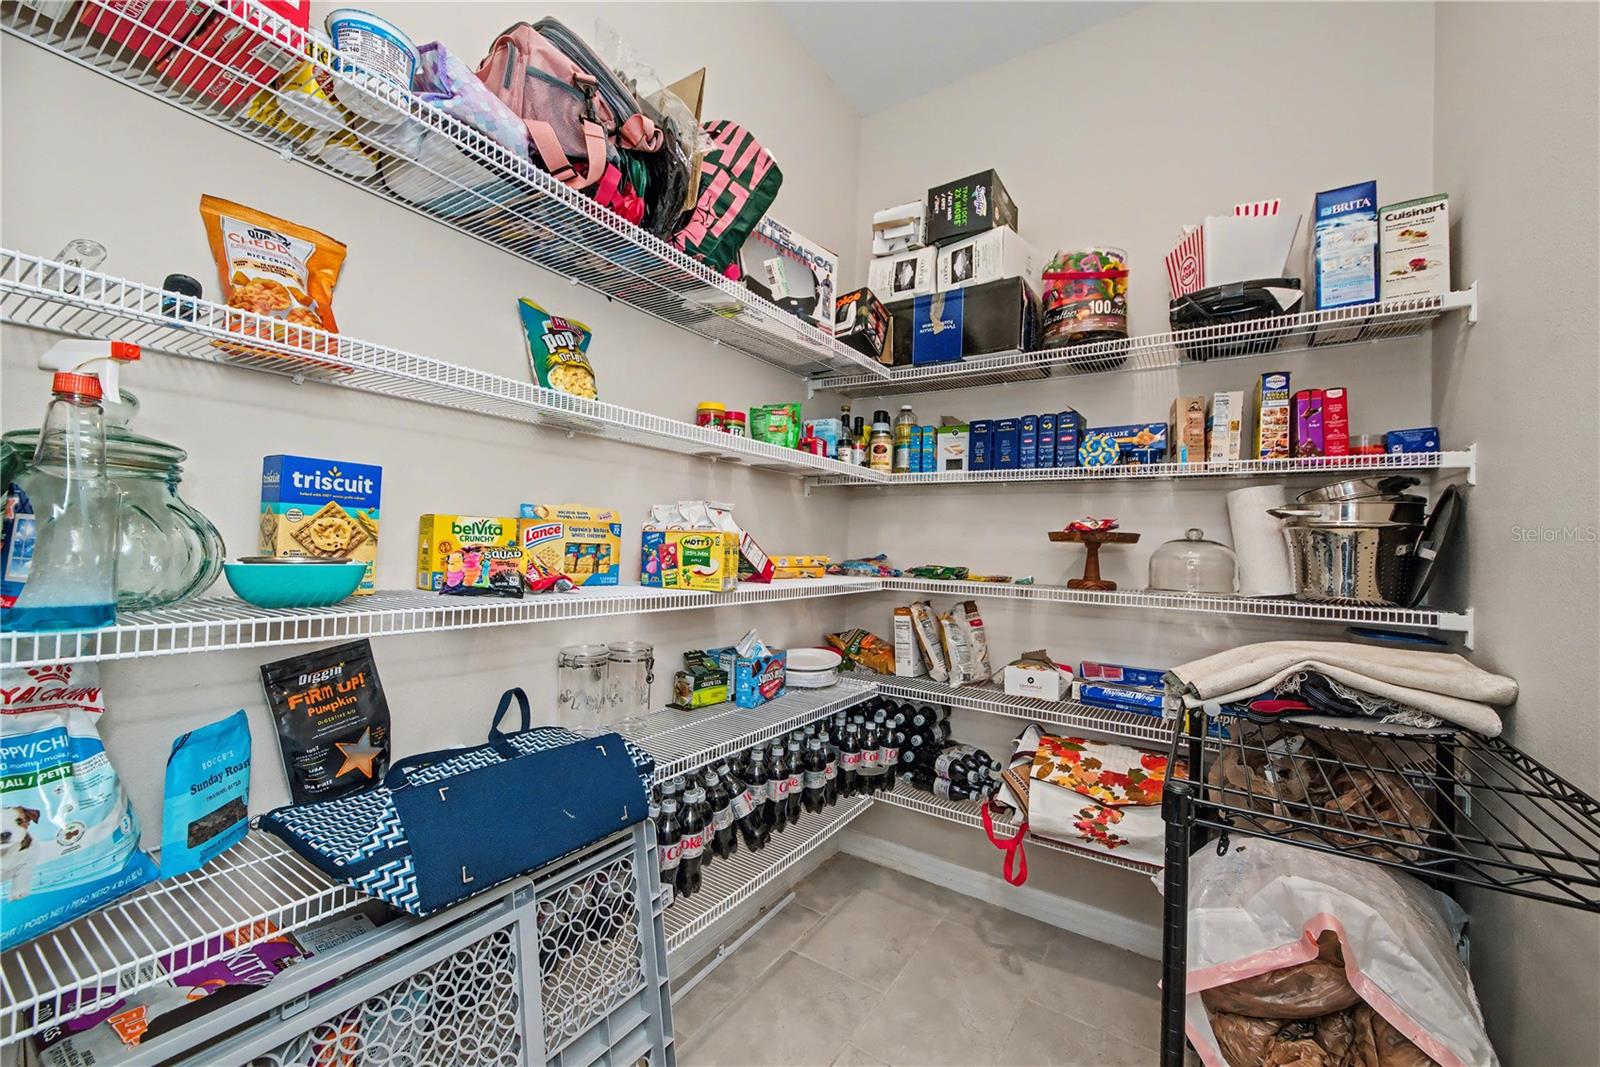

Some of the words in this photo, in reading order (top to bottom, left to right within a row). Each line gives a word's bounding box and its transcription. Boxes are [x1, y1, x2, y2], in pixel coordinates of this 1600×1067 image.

[1331, 198, 1371, 215] BRITA
[1385, 202, 1446, 221] Cuisinart
[1088, 300, 1111, 315] 100
[292, 470, 374, 494] triscuit
[451, 519, 503, 536] belVita
[526, 525, 561, 542] Lance
[459, 535, 495, 543] CRUNCHY
[683, 538, 710, 546] MOTT'S
[484, 550, 523, 559] SQUAD
[190, 771, 223, 796] Sunday
[225, 758, 252, 777] Roast
